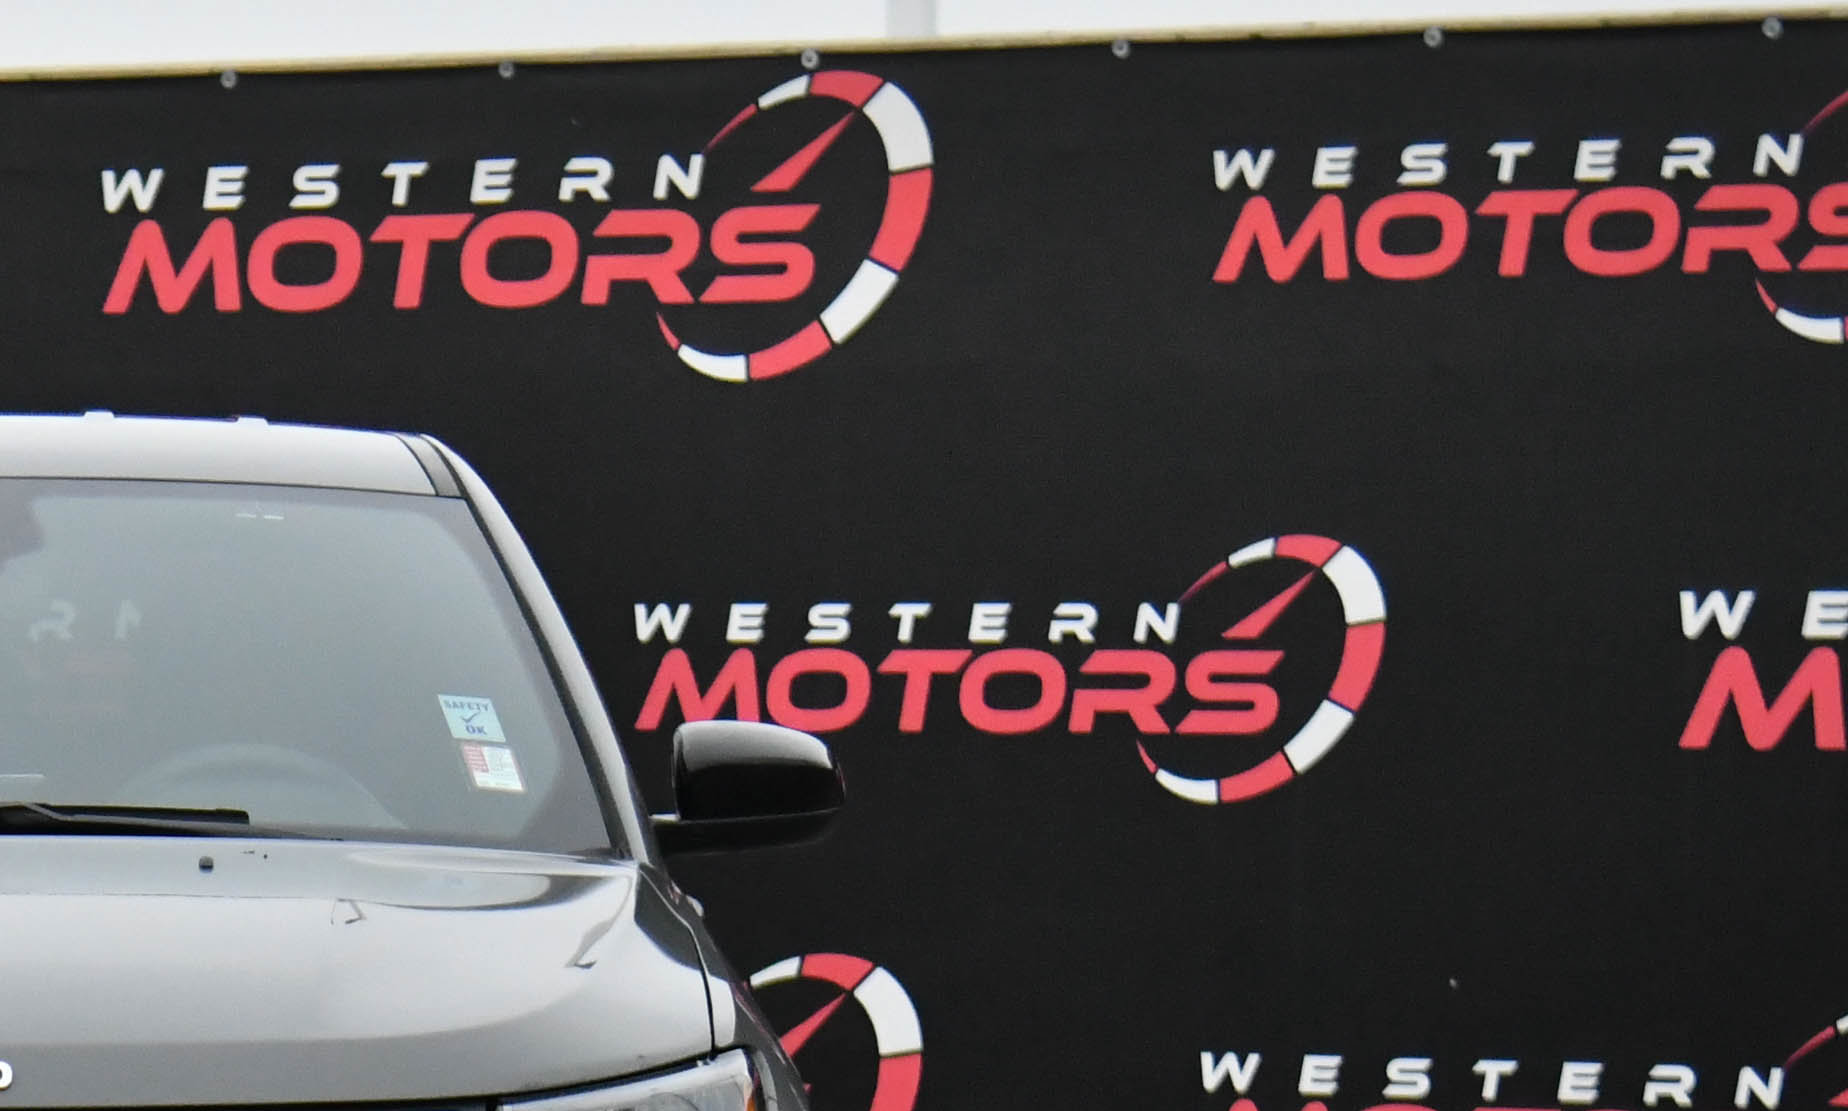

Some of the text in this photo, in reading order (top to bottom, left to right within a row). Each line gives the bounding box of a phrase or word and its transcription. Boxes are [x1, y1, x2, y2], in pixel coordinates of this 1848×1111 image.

[100, 154, 704, 213] WESTERN
[1212, 134, 1804, 191] WESTERN
[103, 204, 821, 315] MOTORS
[633, 602, 1180, 643] WESTERN
[443, 700, 489, 712] SAFETY
[634, 647, 1285, 736] MOTORS
[465, 724, 487, 736] OK
[1199, 1050, 1785, 1109] WESTERN
